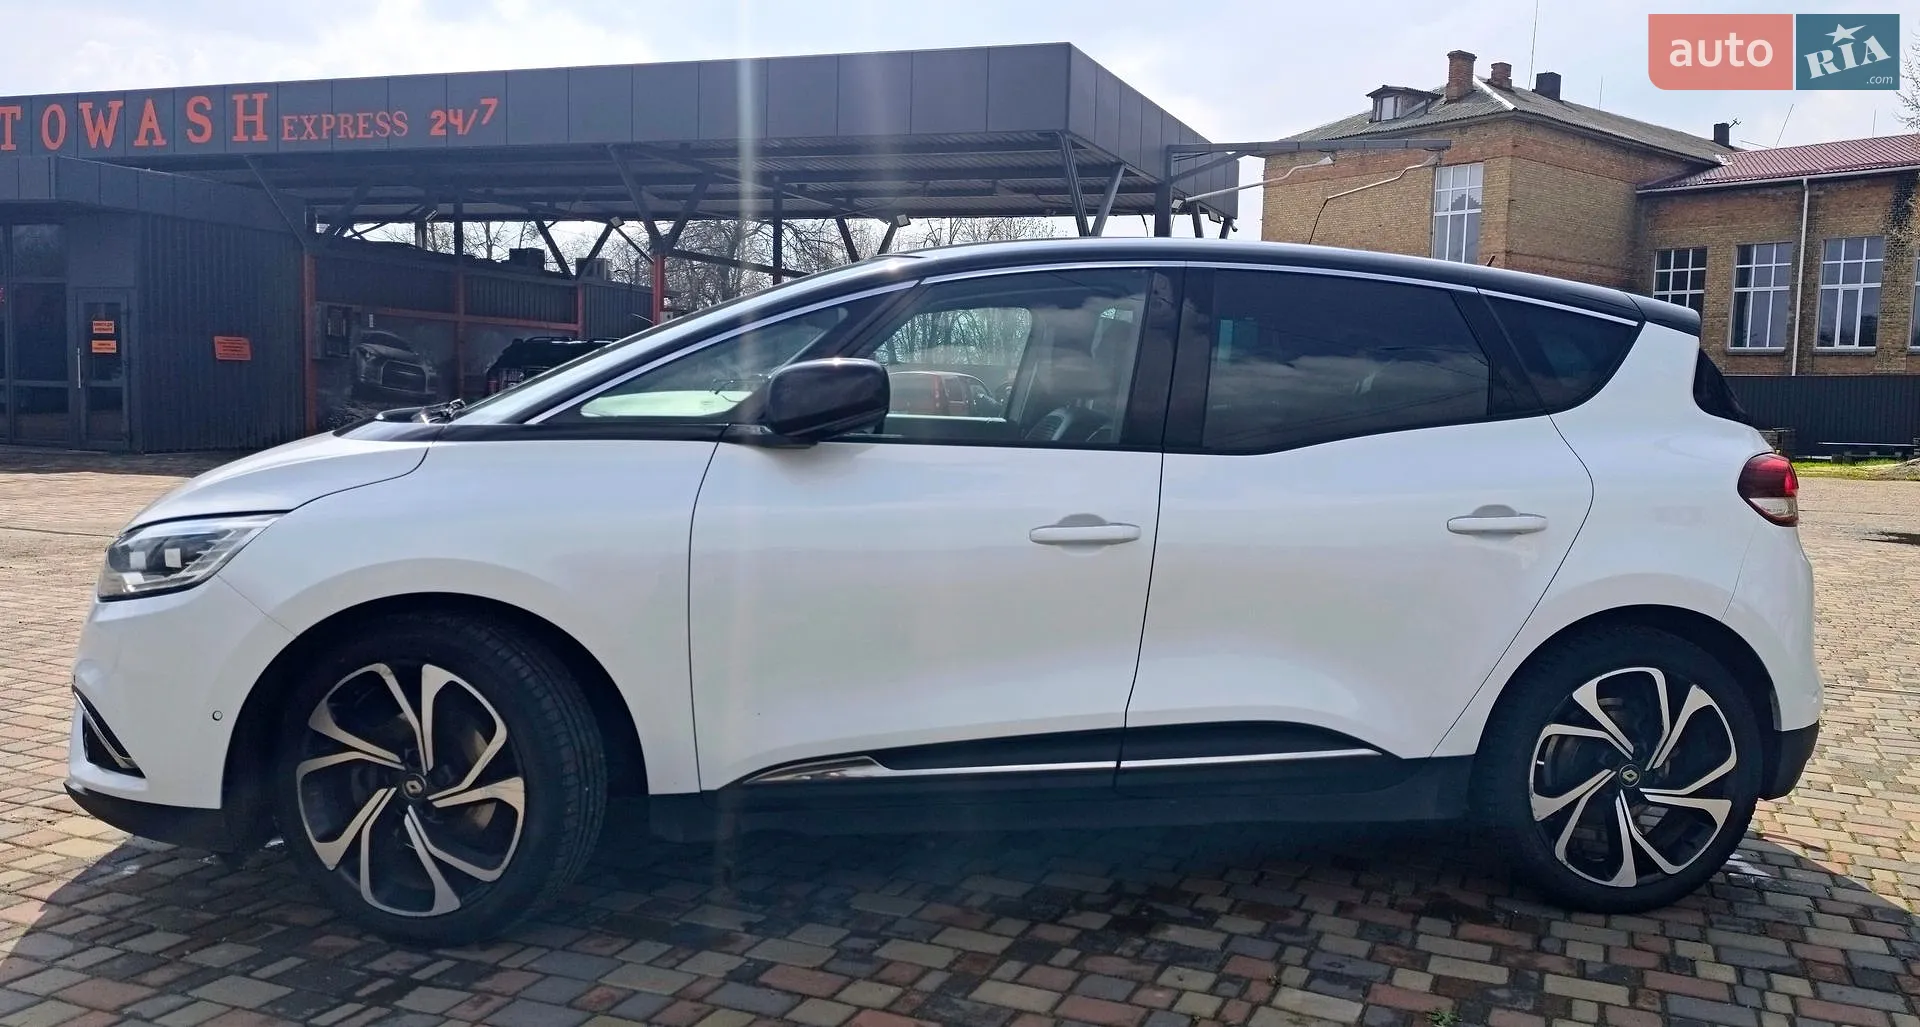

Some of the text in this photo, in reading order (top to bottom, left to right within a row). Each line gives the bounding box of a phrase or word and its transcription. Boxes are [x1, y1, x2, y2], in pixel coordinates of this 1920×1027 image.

[0, 93, 499, 152] TOWASH EXPRESS 24/7
